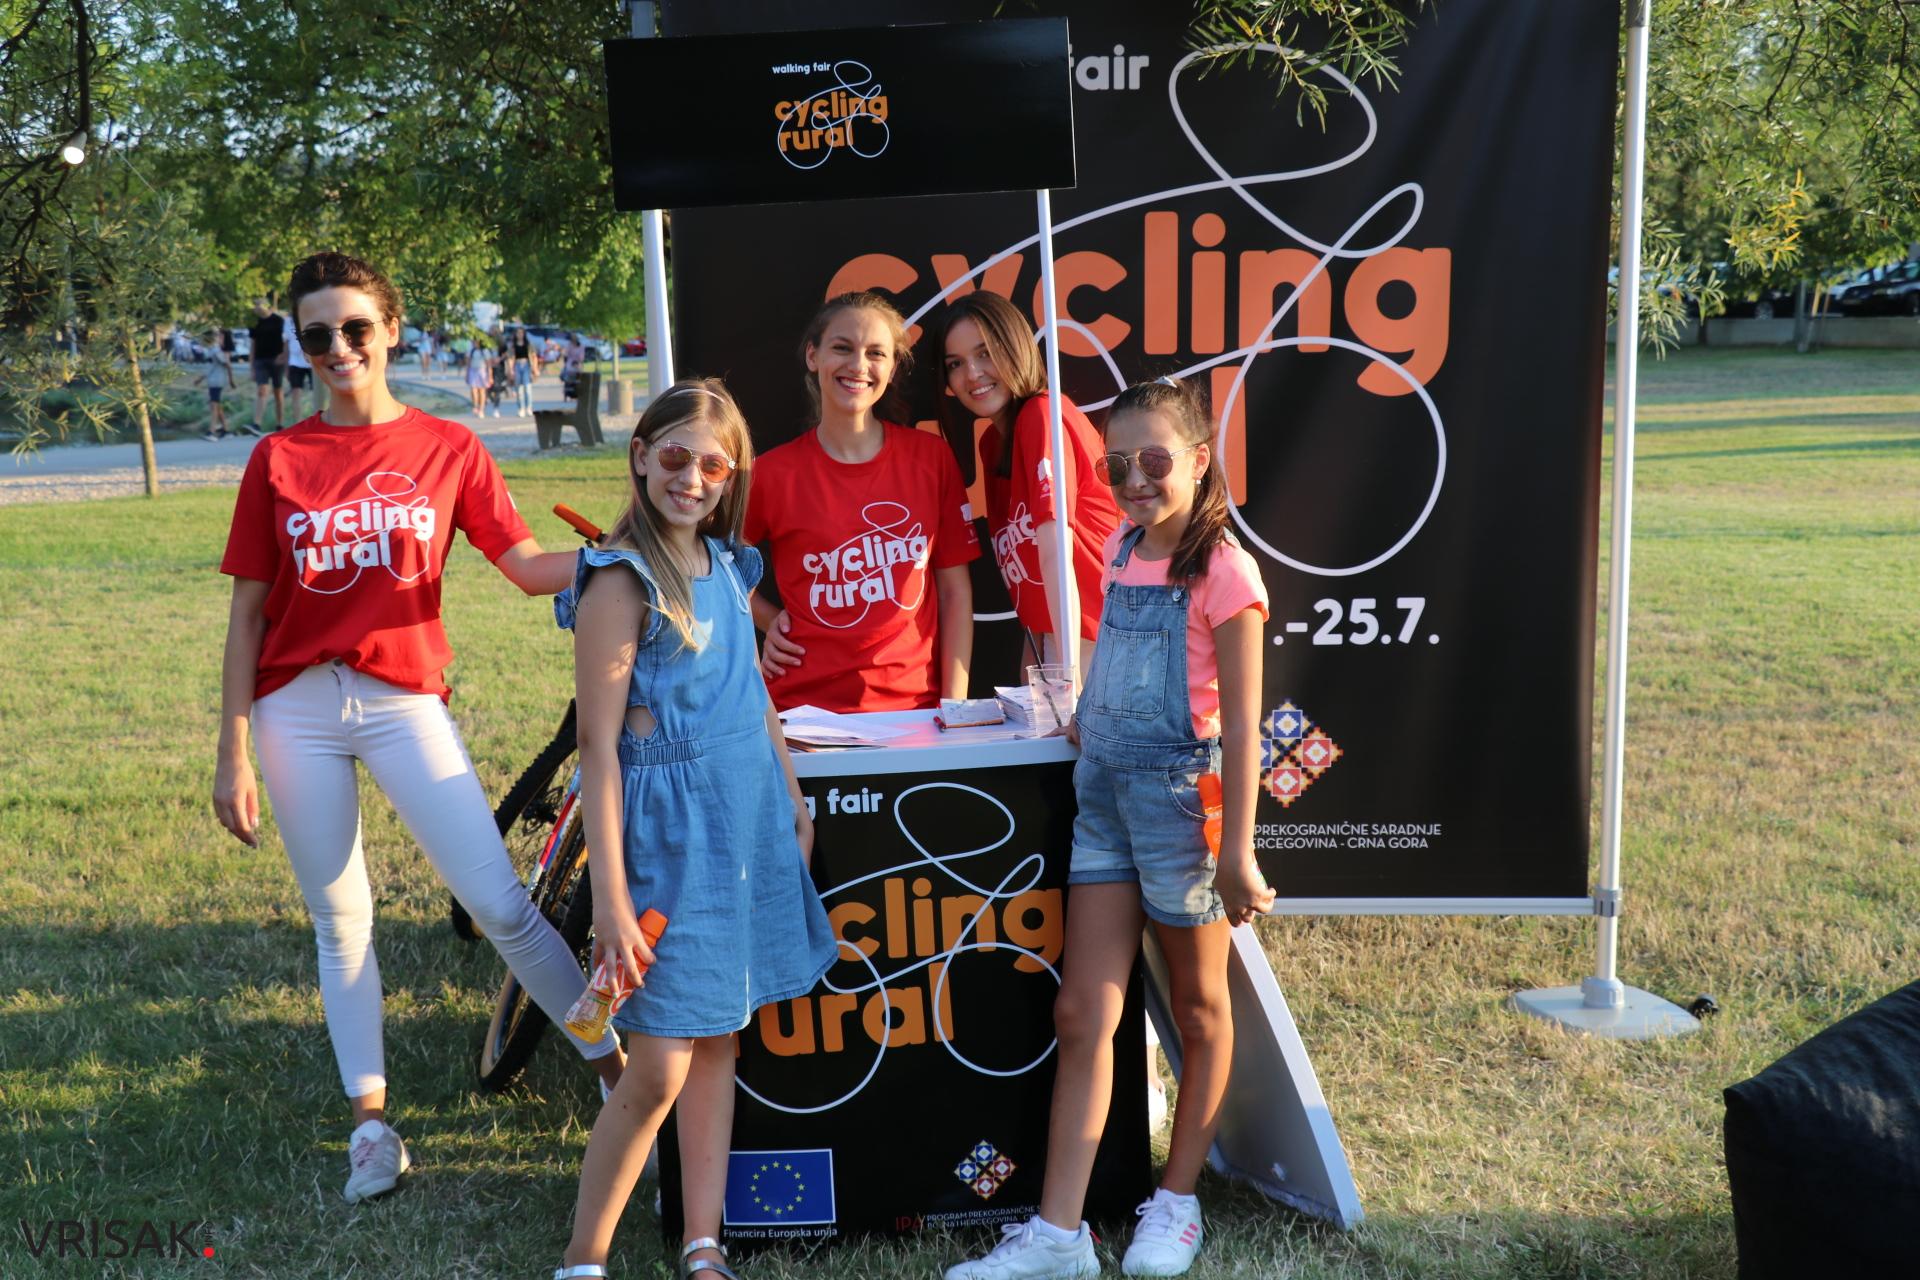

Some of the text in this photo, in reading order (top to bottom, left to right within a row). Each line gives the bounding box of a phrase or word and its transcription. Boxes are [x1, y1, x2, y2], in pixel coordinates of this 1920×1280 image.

[772, 62, 831, 75] walking fair
[1069, 43, 1150, 91] air
[774, 91, 889, 125] cycling
[779, 119, 854, 153] rural
[286, 501, 435, 542] cycling
[295, 530, 391, 574] rural
[803, 533, 928, 581] cycling
[811, 566, 896, 608] rural
[1273, 597, 1440, 645] .-25.7.
[827, 787, 884, 815] fair
[1253, 837, 1338, 849] RCEGOVINA
[1347, 837, 1386, 849] CRNA
[1388, 837, 1429, 849] GORA
[1254, 821, 1442, 836] PREKOGRANIČNE SARADNJE
[826, 877, 1064, 974] cling
[735, 963, 955, 1061] ural
[723, 1229, 766, 1238] Financira
[768, 1228, 811, 1239] Europska
[927, 1212, 967, 1222] PROGRAM
